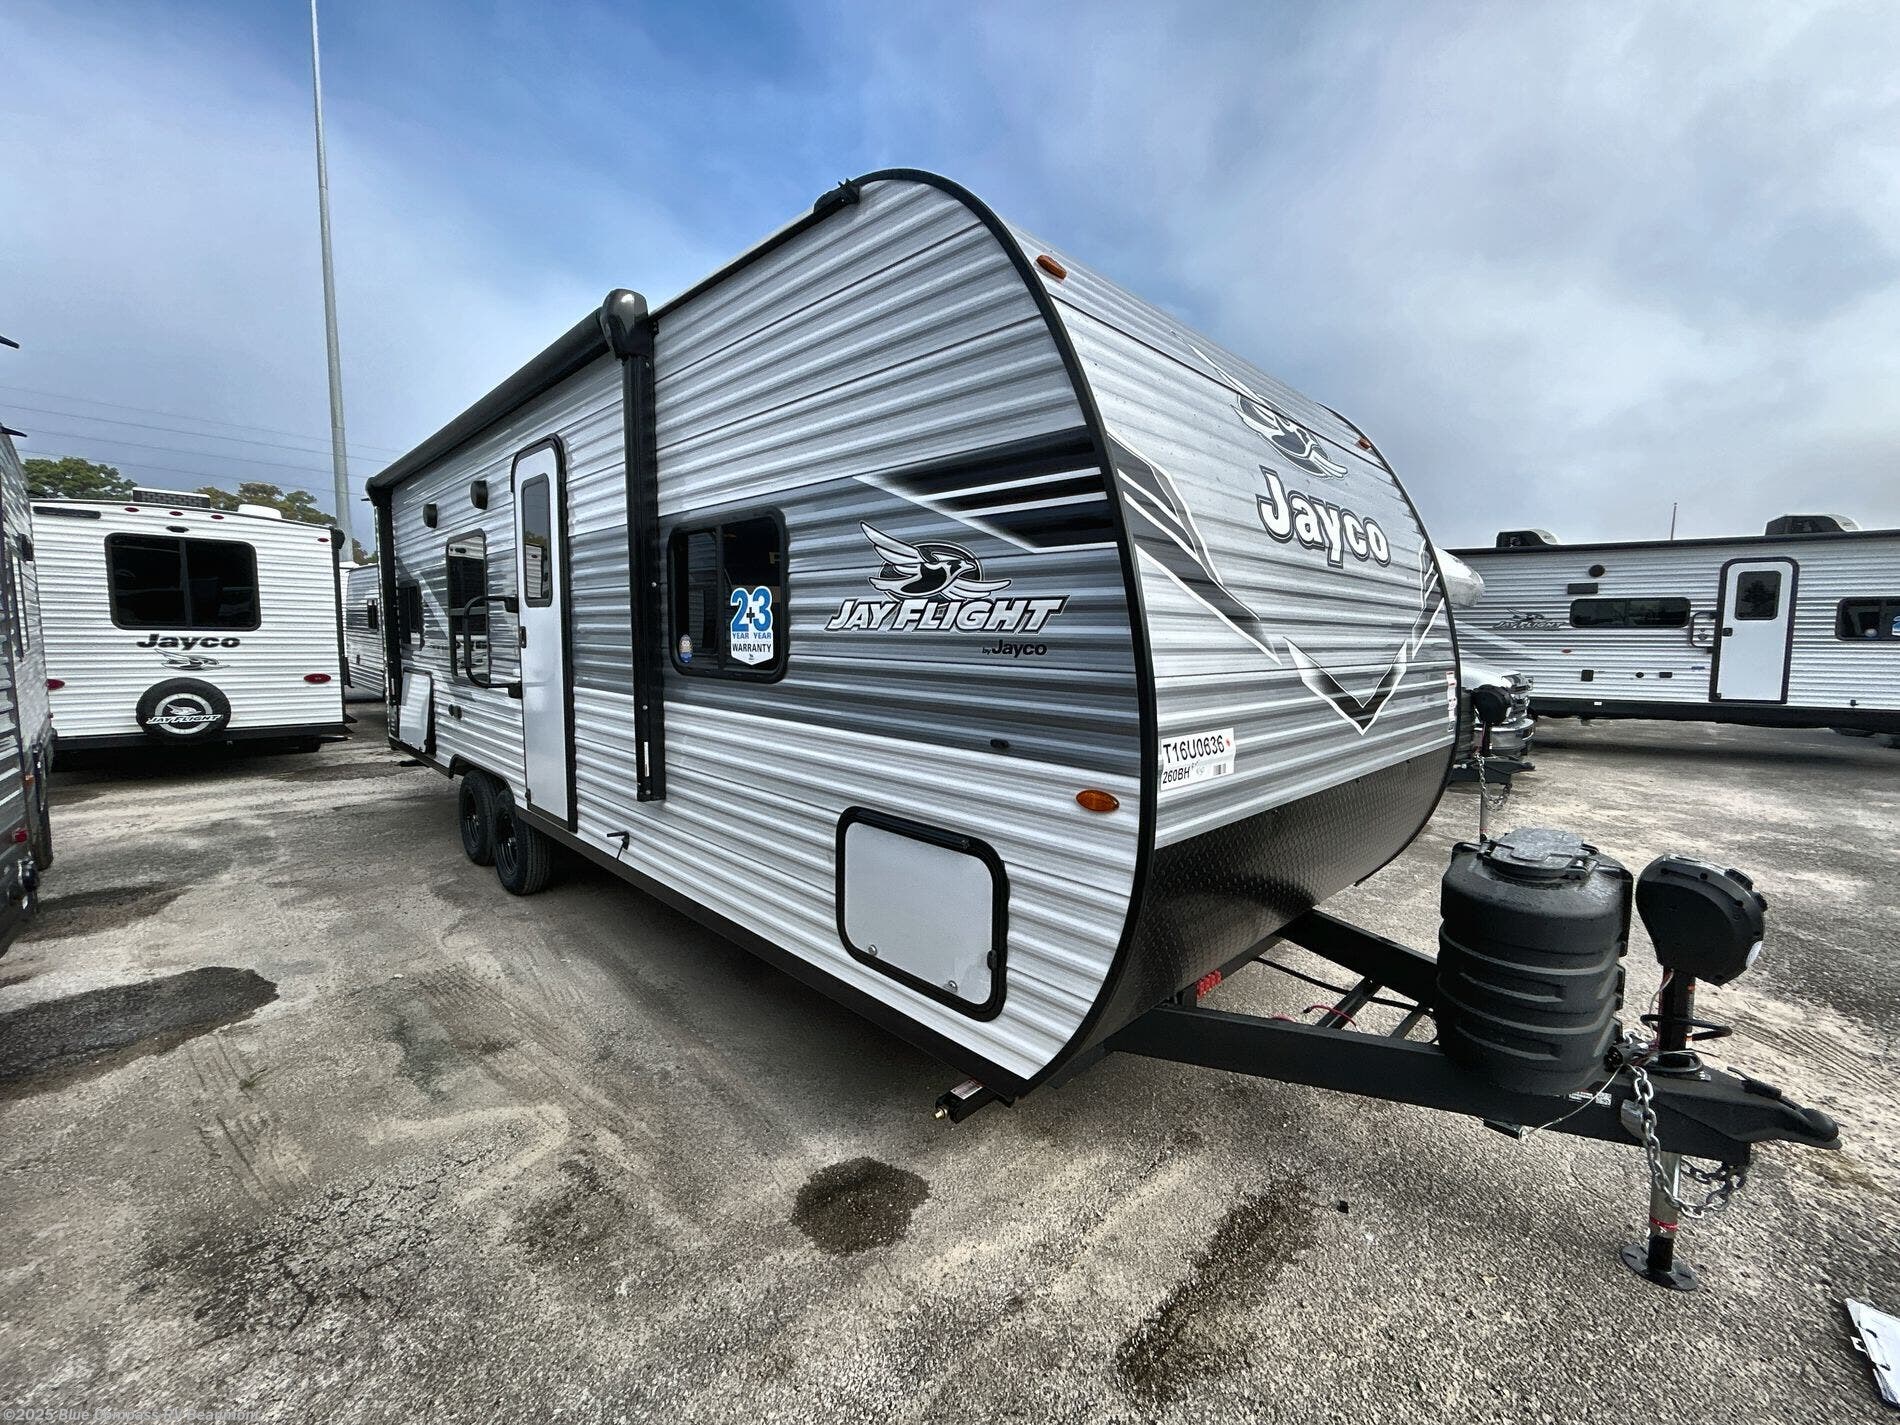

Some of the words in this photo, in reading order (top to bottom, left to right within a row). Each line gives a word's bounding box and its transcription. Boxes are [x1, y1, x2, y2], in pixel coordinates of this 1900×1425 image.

[1255, 464, 1391, 569] Jayco
[825, 599, 899, 631] JAY
[890, 596, 1069, 633] FLIGHT
[136, 633, 241, 650] Jayco
[732, 632, 749, 640] YEAR
[753, 632, 772, 640] YEAR
[732, 643, 772, 653] WARRANTY
[982, 647, 991, 655] by
[991, 640, 1048, 656] Jayco
[1163, 735, 1225, 763] T16U0636
[1162, 766, 1191, 784] 260BH
